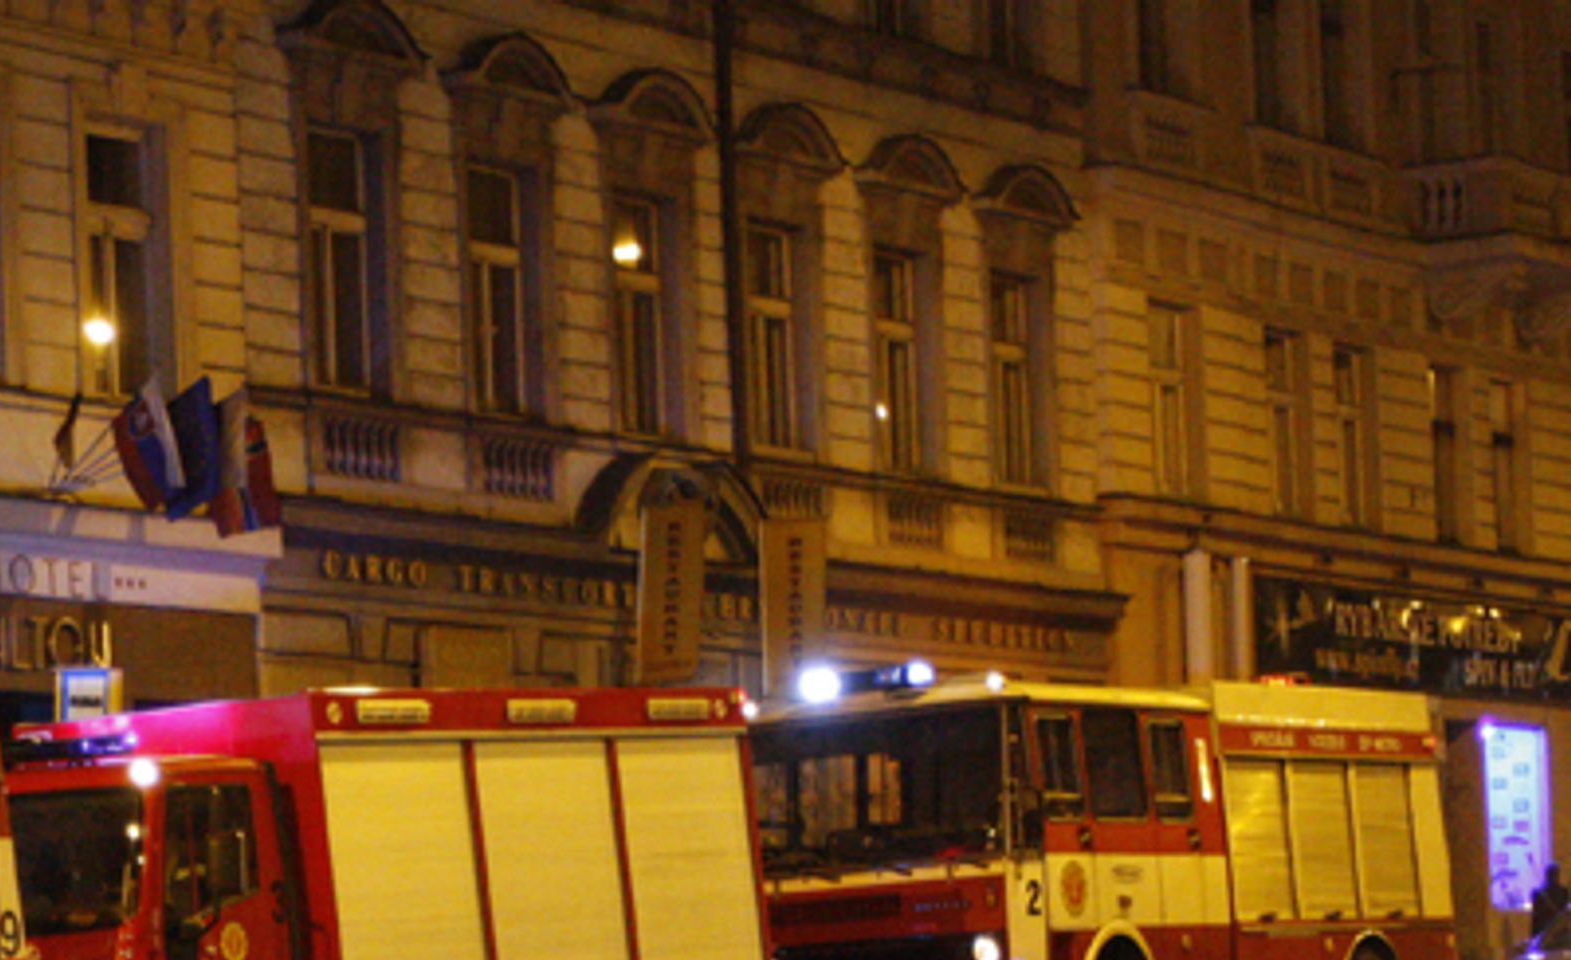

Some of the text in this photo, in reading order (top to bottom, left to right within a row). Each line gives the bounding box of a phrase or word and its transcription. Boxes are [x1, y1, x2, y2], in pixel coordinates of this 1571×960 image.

[322, 548, 428, 588] CARGO
[1027, 880, 1041, 916] 2
[0, 910, 20, 957] 9
